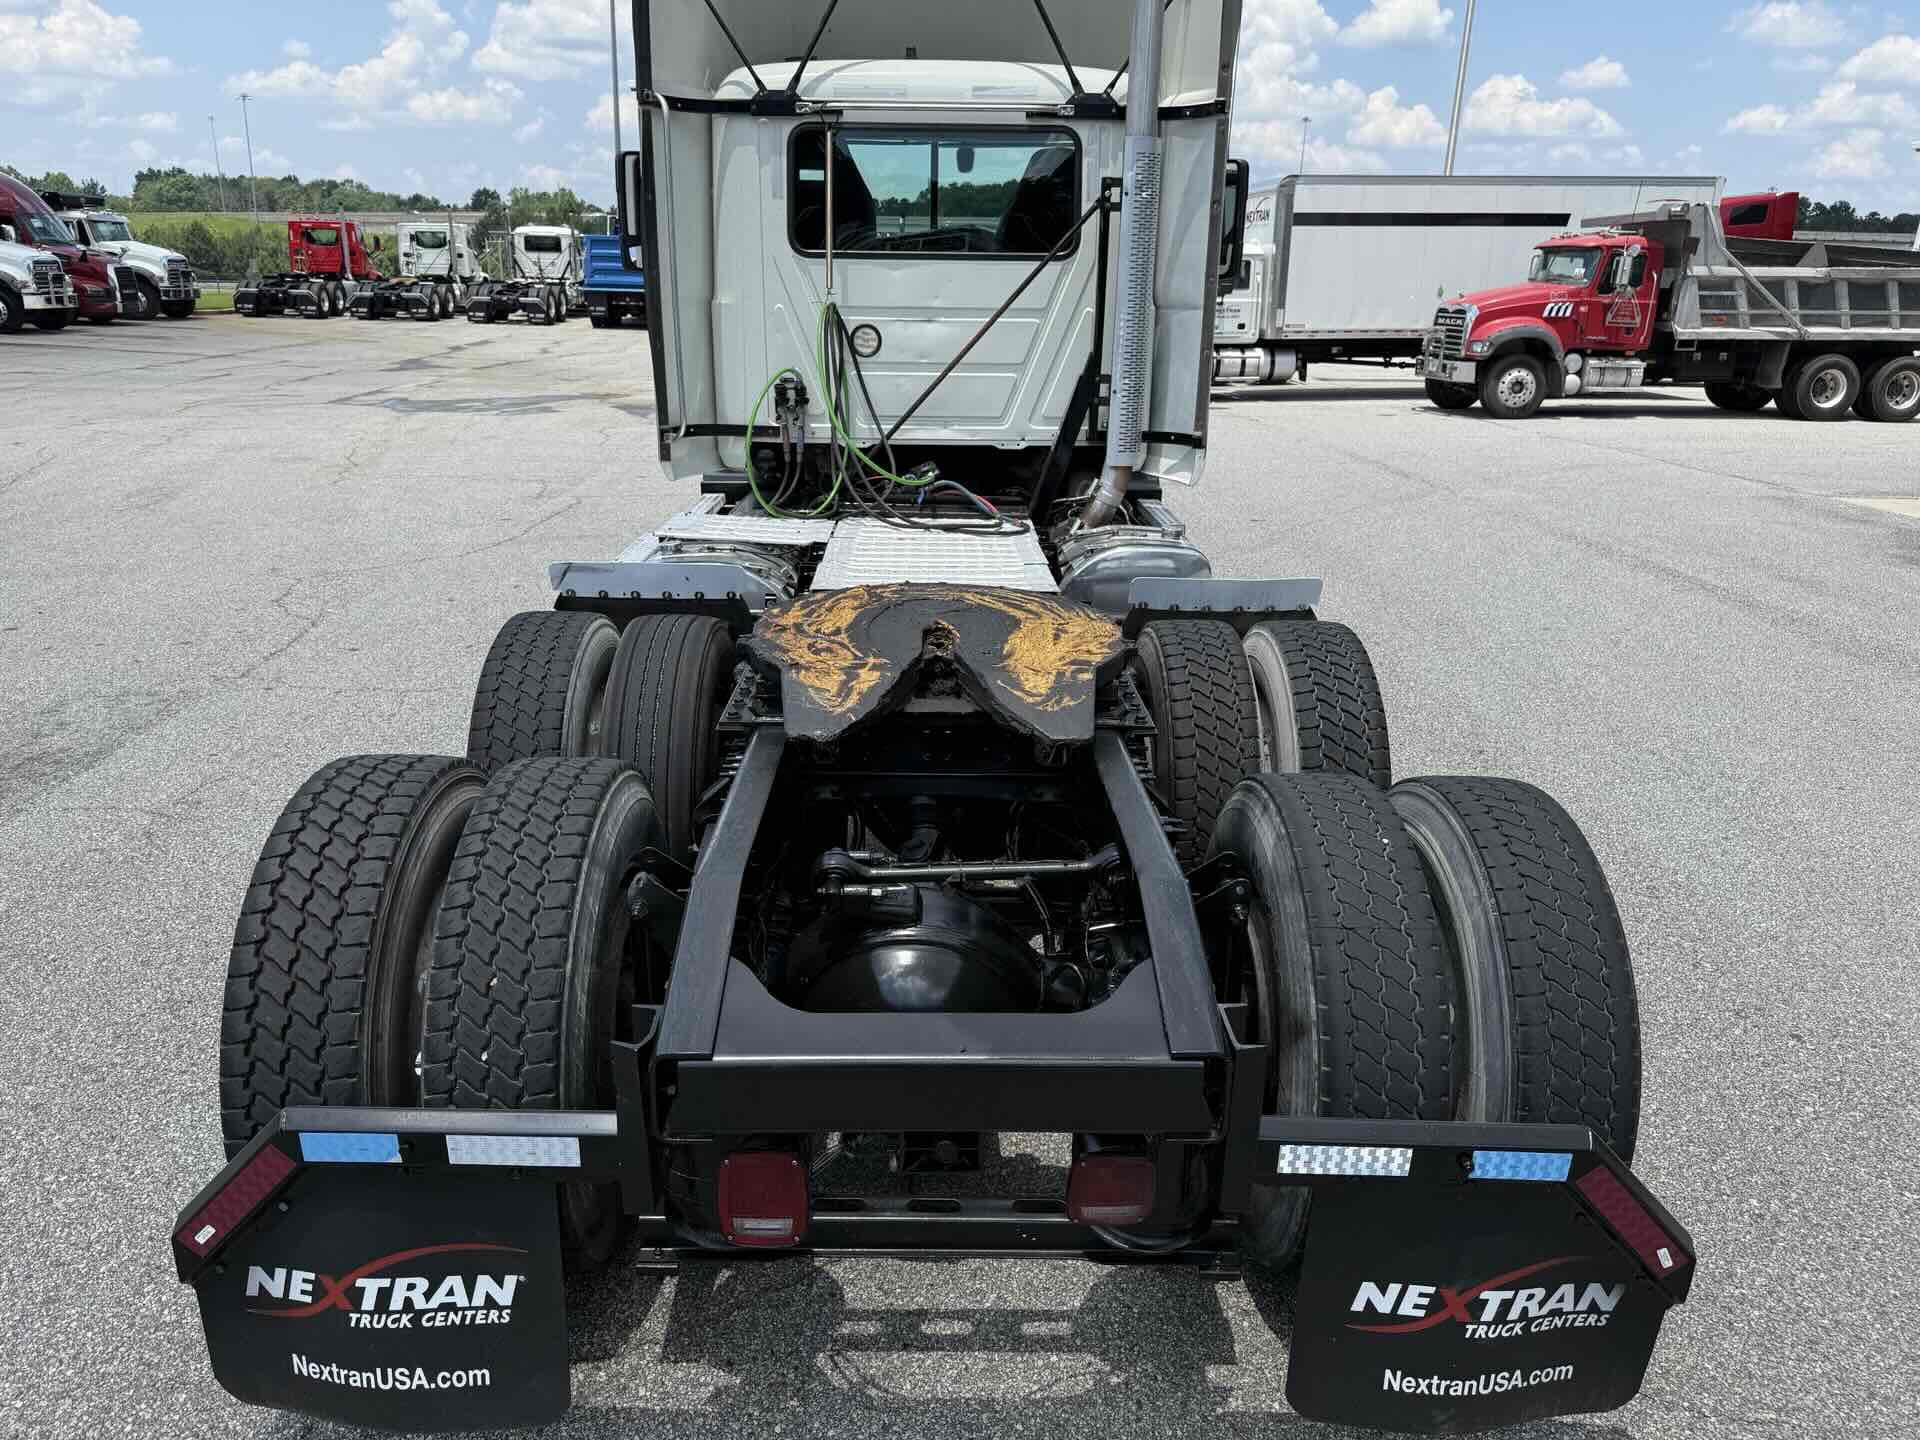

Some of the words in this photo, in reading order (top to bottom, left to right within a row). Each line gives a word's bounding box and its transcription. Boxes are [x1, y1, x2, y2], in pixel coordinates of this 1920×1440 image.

[1437, 316, 1465, 326] MACK
[245, 1265, 519, 1312] NEXTRAN
[1350, 1281, 1626, 1323] NEXTRAN
[349, 1312, 414, 1329] TRUCK
[421, 1309, 511, 1327] CENTERS
[1464, 1322, 1524, 1339] TRUCK
[1530, 1313, 1610, 1333] CENTERS
[292, 1353, 491, 1391] NextranUSA.com
[1382, 1363, 1574, 1396] NextranUSA.com
